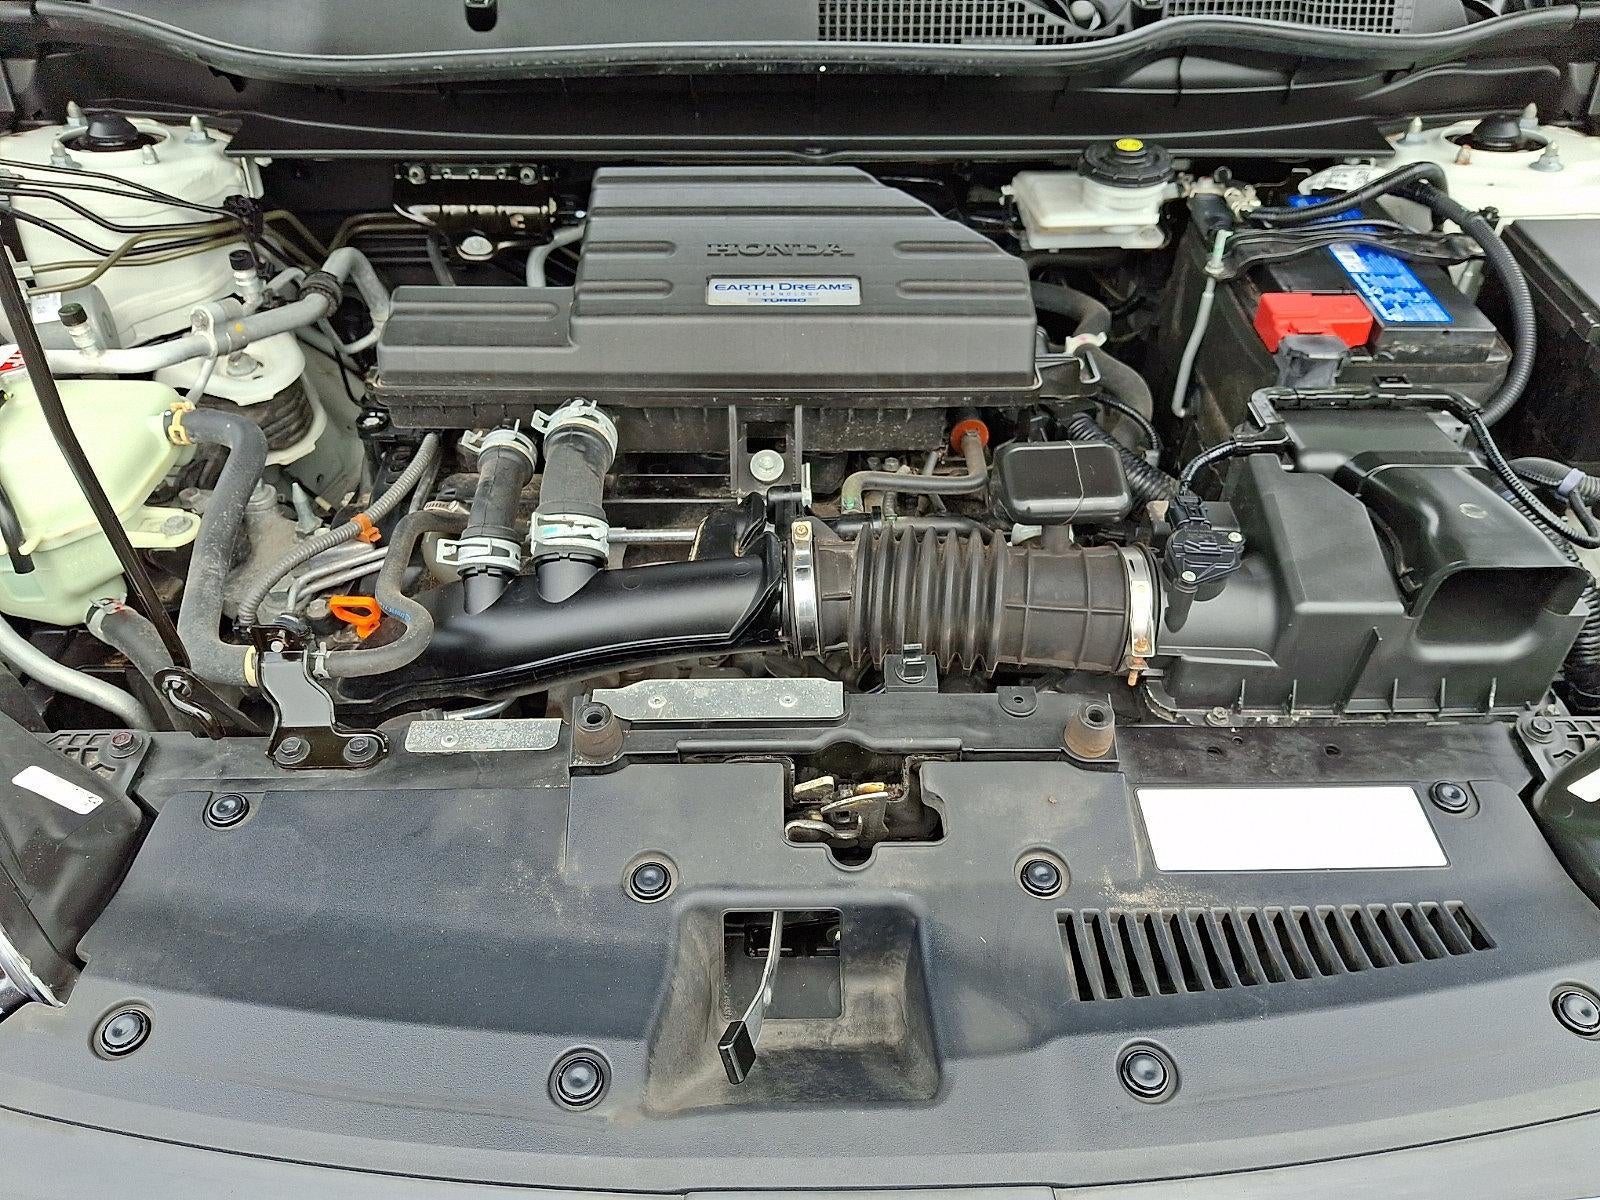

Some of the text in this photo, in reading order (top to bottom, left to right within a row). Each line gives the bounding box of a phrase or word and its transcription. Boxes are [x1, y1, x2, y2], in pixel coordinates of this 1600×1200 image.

[706, 243, 855, 257] HONDA
[714, 282, 853, 291] EARTH DREAMS
